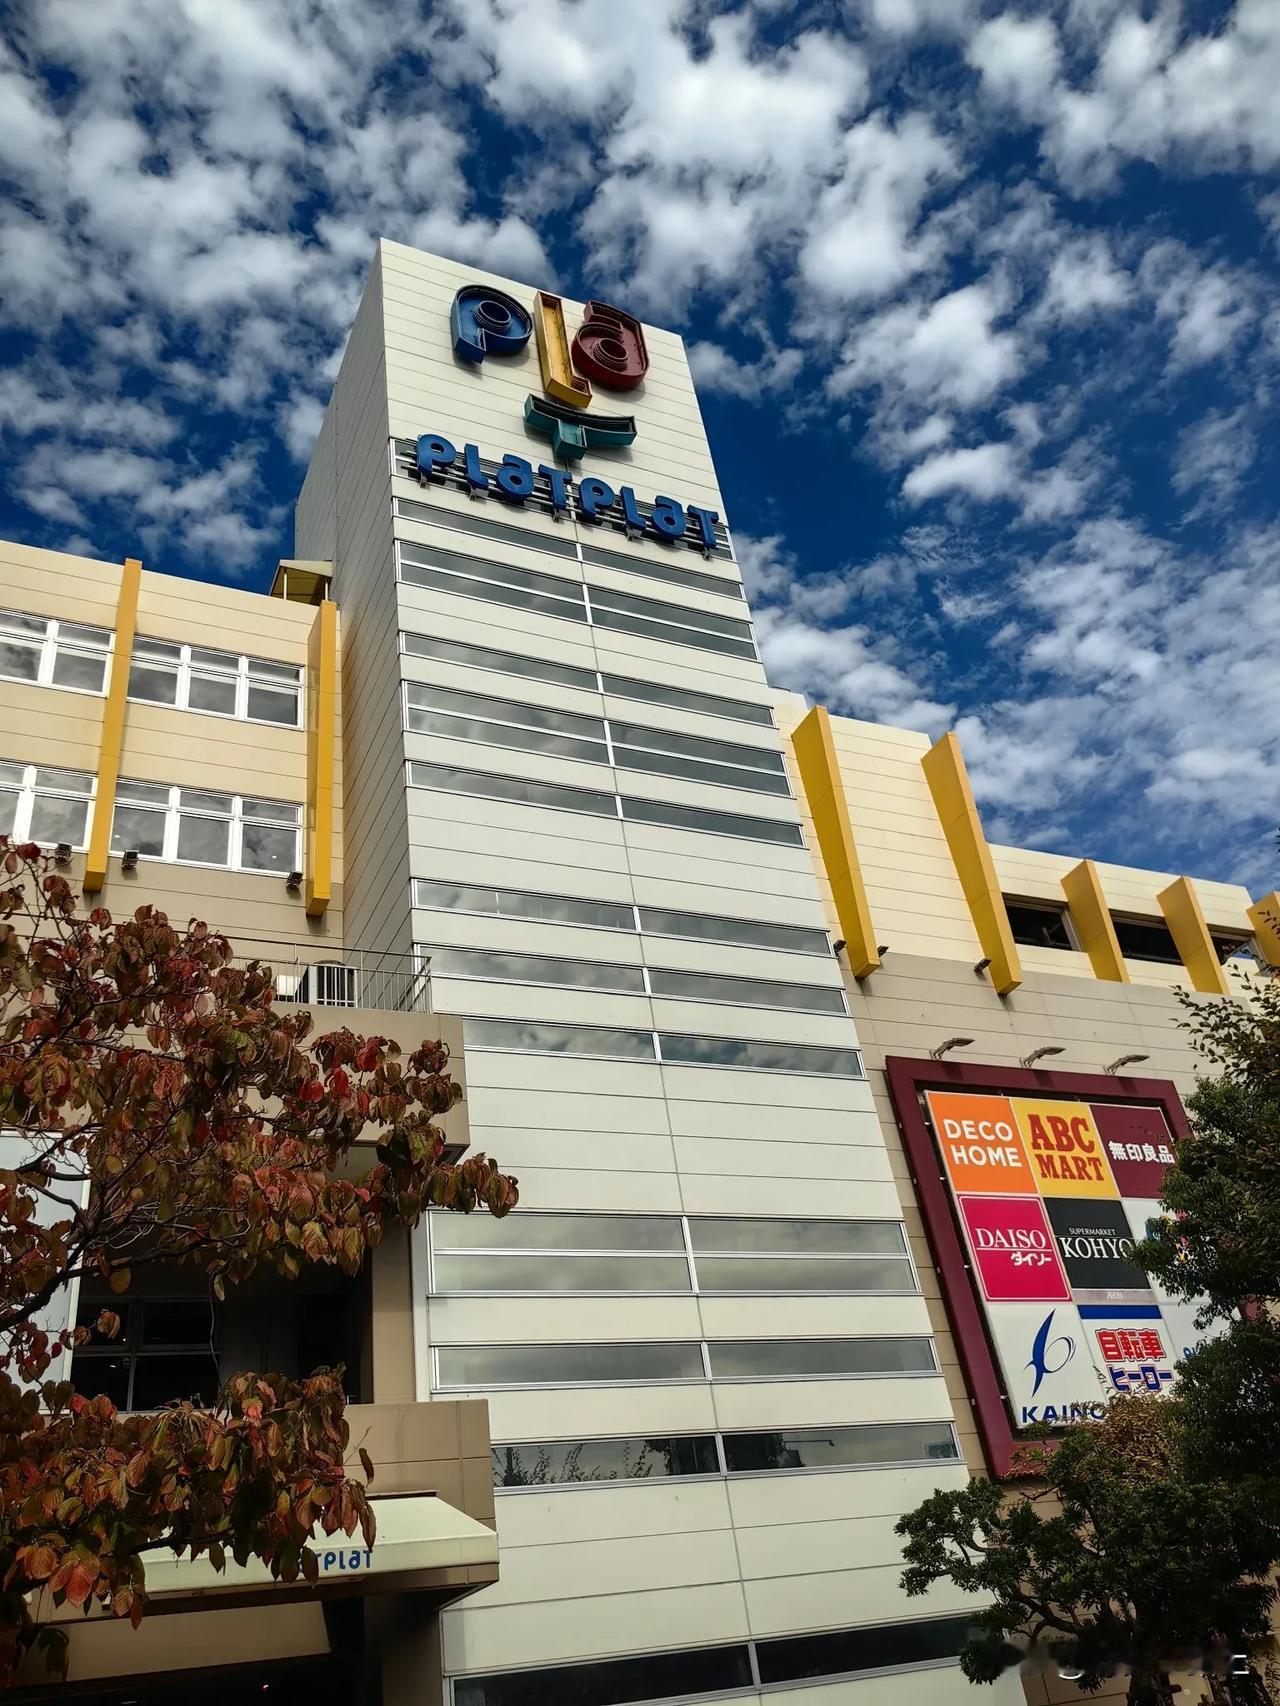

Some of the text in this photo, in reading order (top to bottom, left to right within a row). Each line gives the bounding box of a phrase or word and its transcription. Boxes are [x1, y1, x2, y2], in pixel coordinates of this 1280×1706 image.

[943, 1119, 1014, 1141] DECO
[1028, 1114, 1095, 1153] ABC
[951, 1145, 1023, 1167] HOME
[1108, 1141, 1175, 1164] 無印良品
[1035, 1154, 1104, 1181] MART
[975, 1228, 1046, 1249] DAISO
[1069, 1227, 1116, 1236] SUPERMARKET
[1011, 1251, 1052, 1266] ダイソー
[1095, 1328, 1166, 1361] 自転車
[1106, 1364, 1174, 1392] ヒーロー
